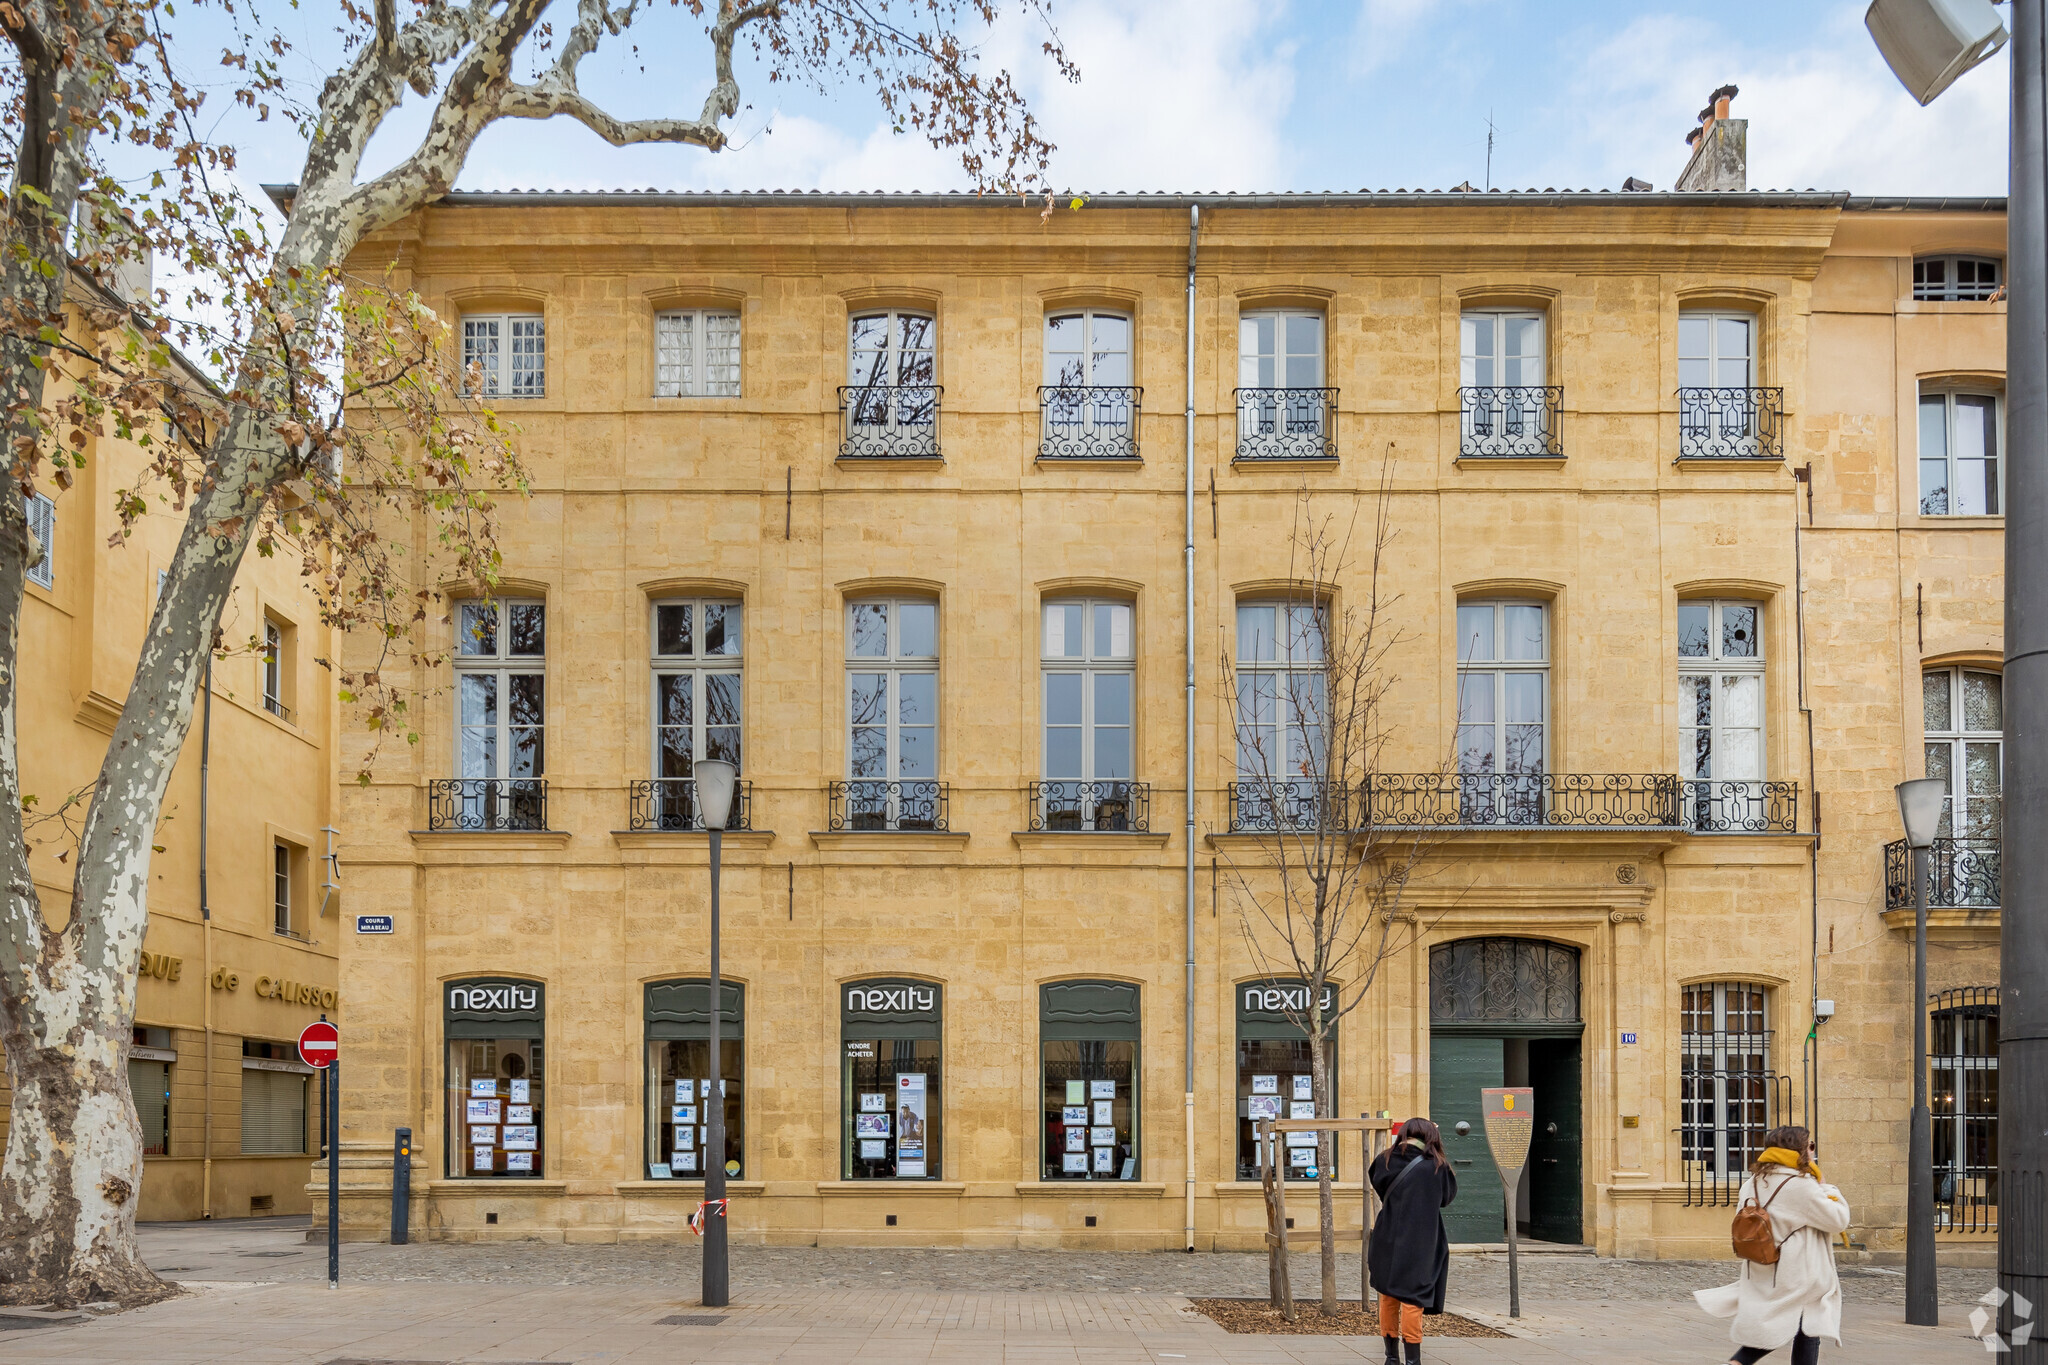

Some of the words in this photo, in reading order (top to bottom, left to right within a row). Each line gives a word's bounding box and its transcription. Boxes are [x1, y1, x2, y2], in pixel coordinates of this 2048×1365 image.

[211, 967, 240, 992] de
[450, 985, 537, 1010] nexity
[848, 986, 934, 1011] nexity
[1625, 1034, 1635, 1043] 10
